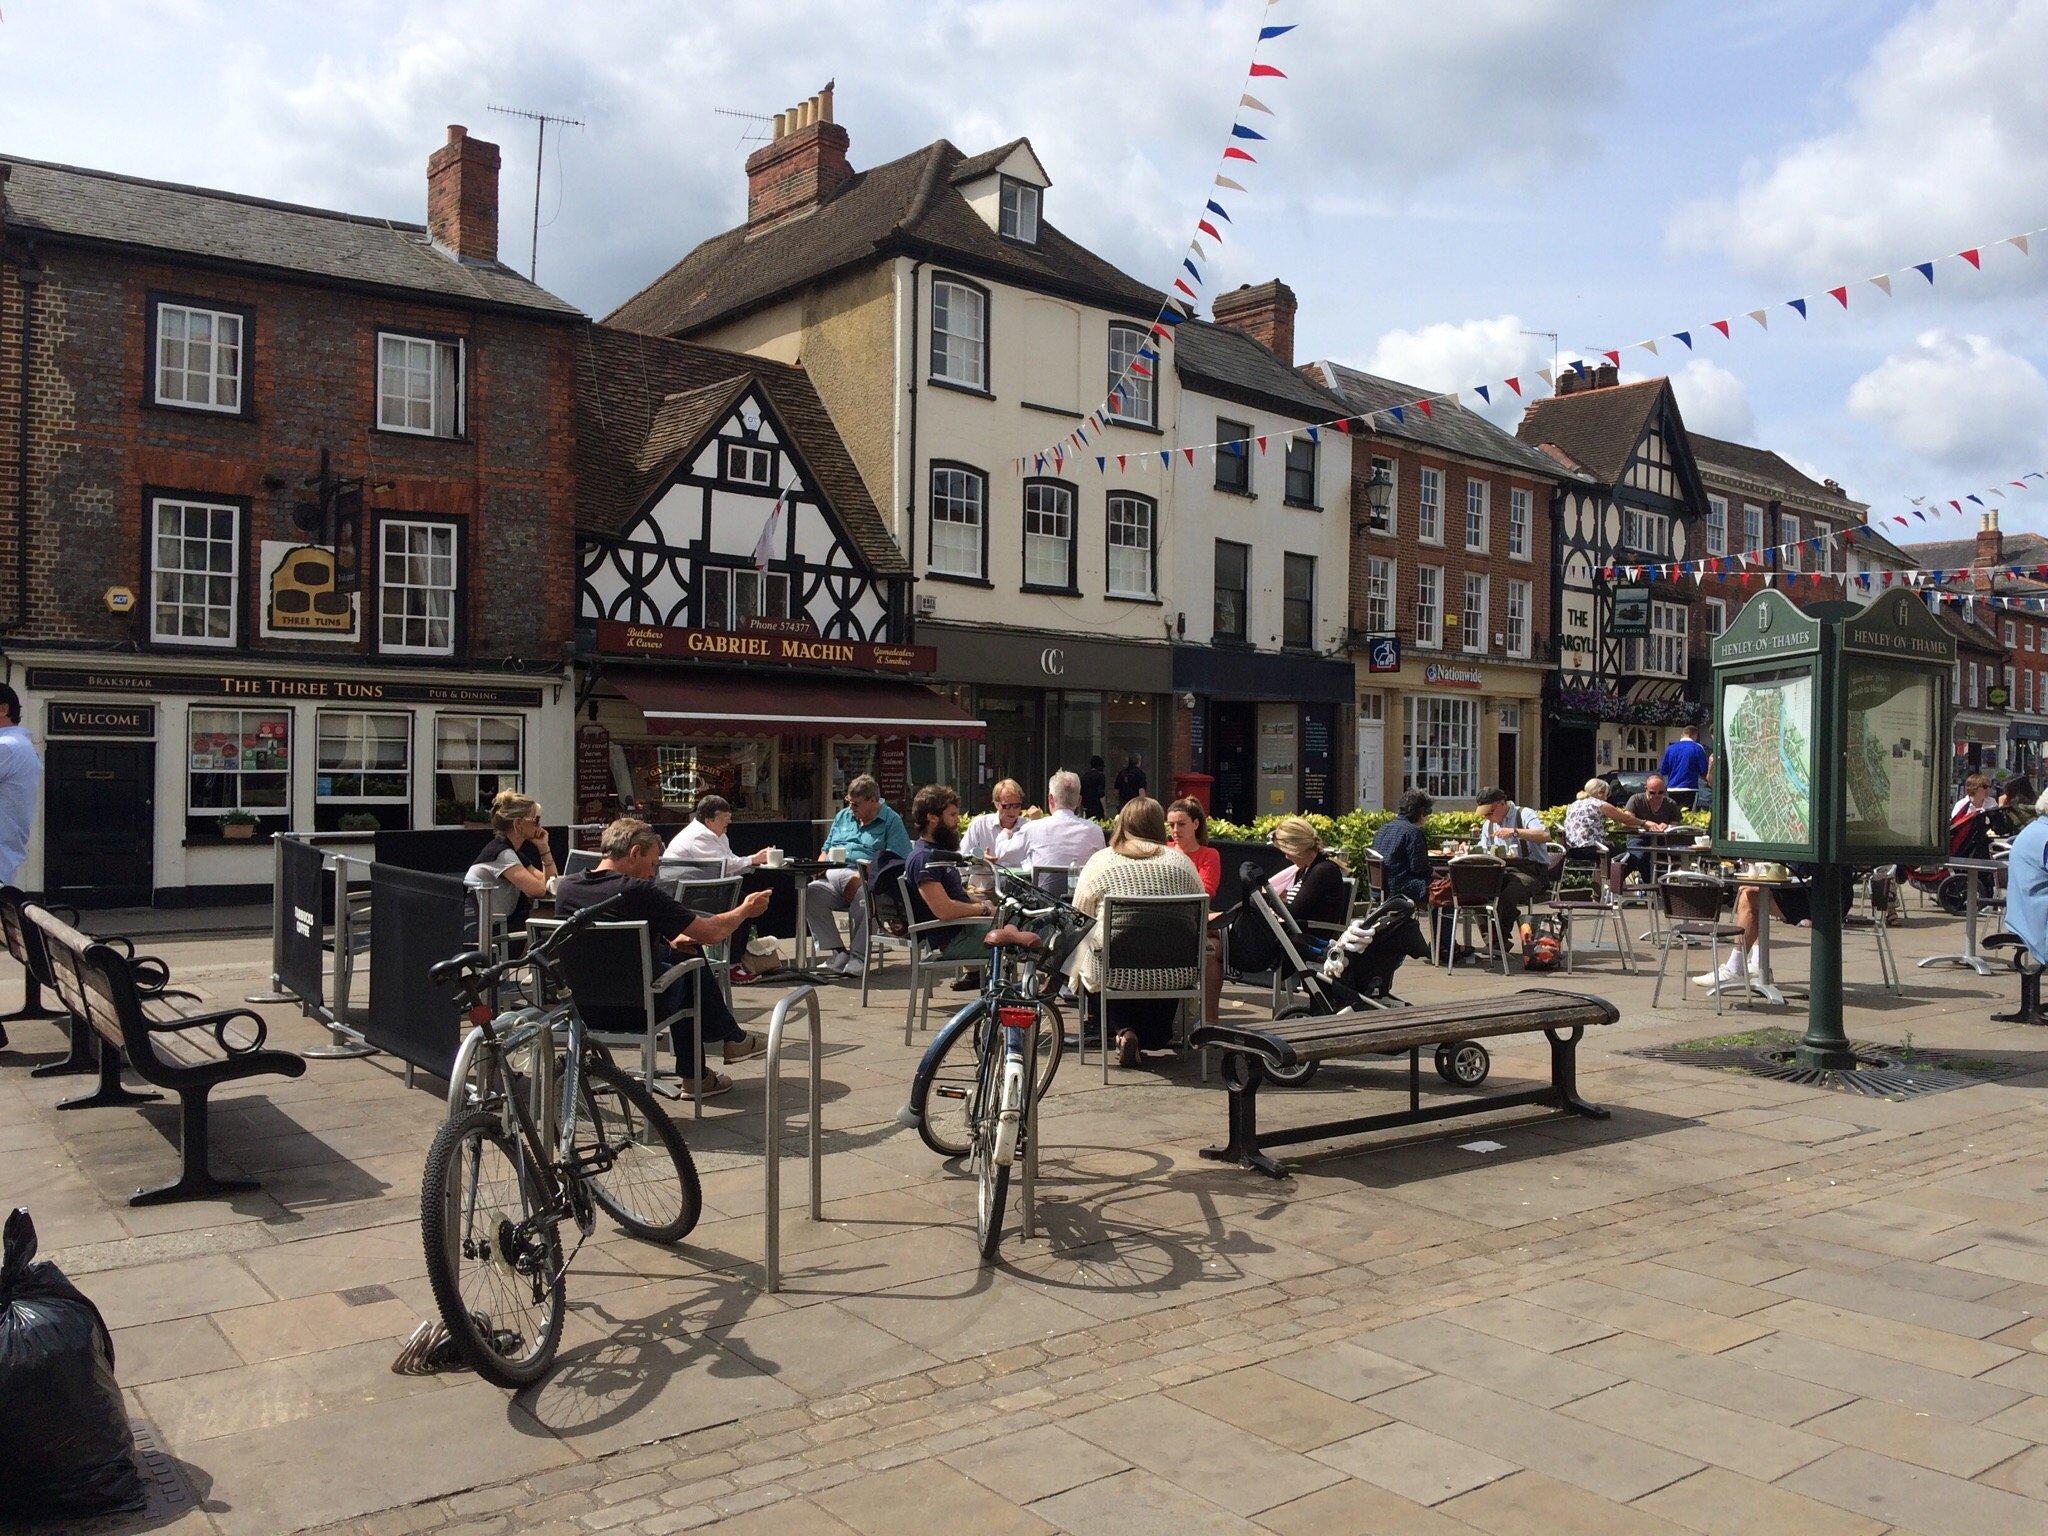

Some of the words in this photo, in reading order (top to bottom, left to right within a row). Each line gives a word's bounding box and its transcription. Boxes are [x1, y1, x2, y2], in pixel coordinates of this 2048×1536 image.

[281, 616, 310, 624] THREE
[315, 617, 341, 626] TUNS
[1567, 608, 1588, 628] THE
[750, 619, 778, 630] Phone
[779, 621, 810, 633] 574377
[626, 627, 664, 639] Butchers
[626, 638, 634, 647] &
[636, 638, 663, 649] Curers
[688, 633, 771, 656] GABRIEL
[781, 640, 854, 662] MACHIN
[873, 646, 915, 658] Gamedealers
[884, 657, 912, 666] Smokers
[1437, 664, 1482, 683] Nationwide
[88, 676, 152, 687] BRAKSPEAR
[220, 677, 261, 694] THE
[266, 679, 328, 696] THREE
[333, 682, 383, 698] TUNS
[429, 689, 448, 698] PUB
[450, 690, 458, 699] &
[460, 691, 498, 700] DINING
[62, 711, 140, 726] WELCOME
